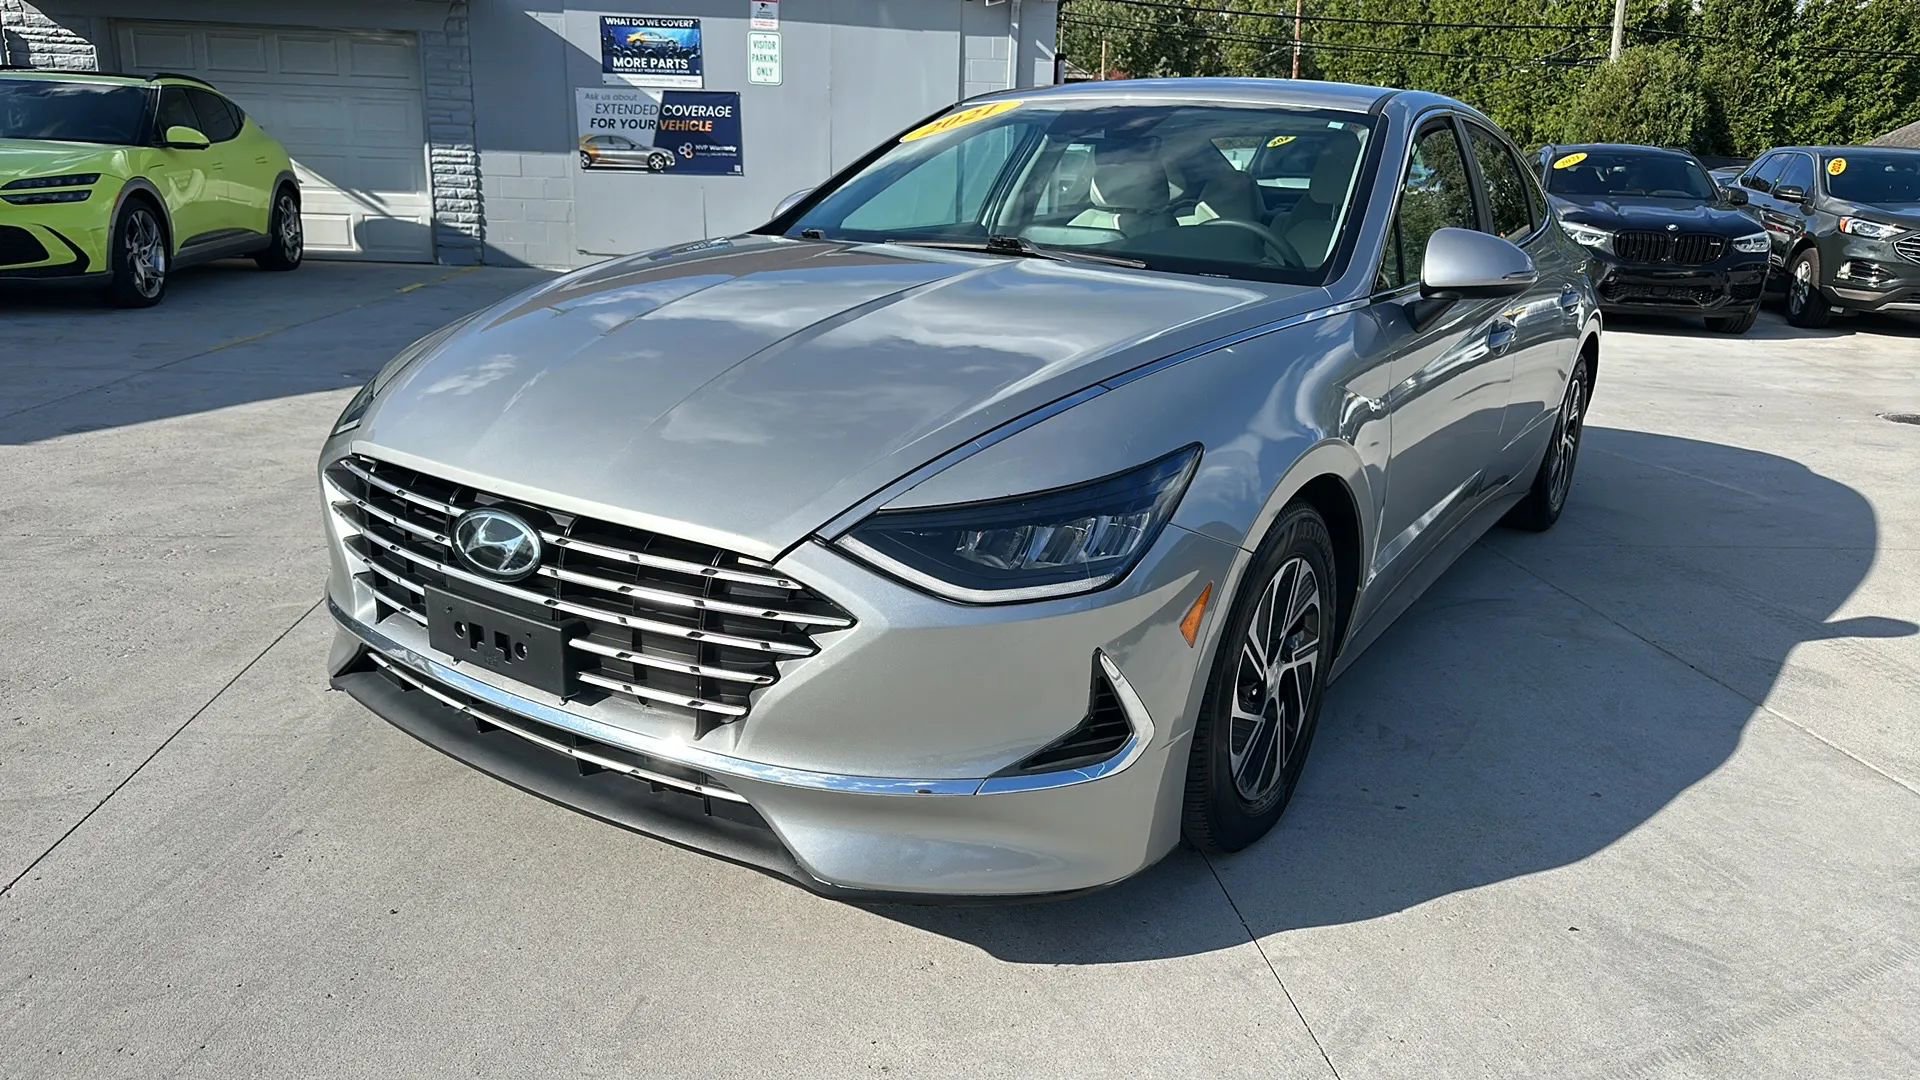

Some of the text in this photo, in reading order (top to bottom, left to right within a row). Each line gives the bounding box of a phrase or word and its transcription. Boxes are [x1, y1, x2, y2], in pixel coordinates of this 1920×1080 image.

[605, 17, 694, 28] WHAT DO WE COVER?
[753, 40, 776, 50] VISITOR
[612, 57, 689, 69] MORE PARTS
[751, 53, 778, 63] PARKING
[756, 67, 773, 76] ONLY
[584, 92, 599, 100] Ask
[612, 92, 637, 101] about
[595, 103, 732, 118] EXTENDED COVERAGE
[590, 118, 713, 132] FOR YOUR VEHICLE
[920, 104, 999, 136] 2021
[709, 144, 737, 153] Warranty
